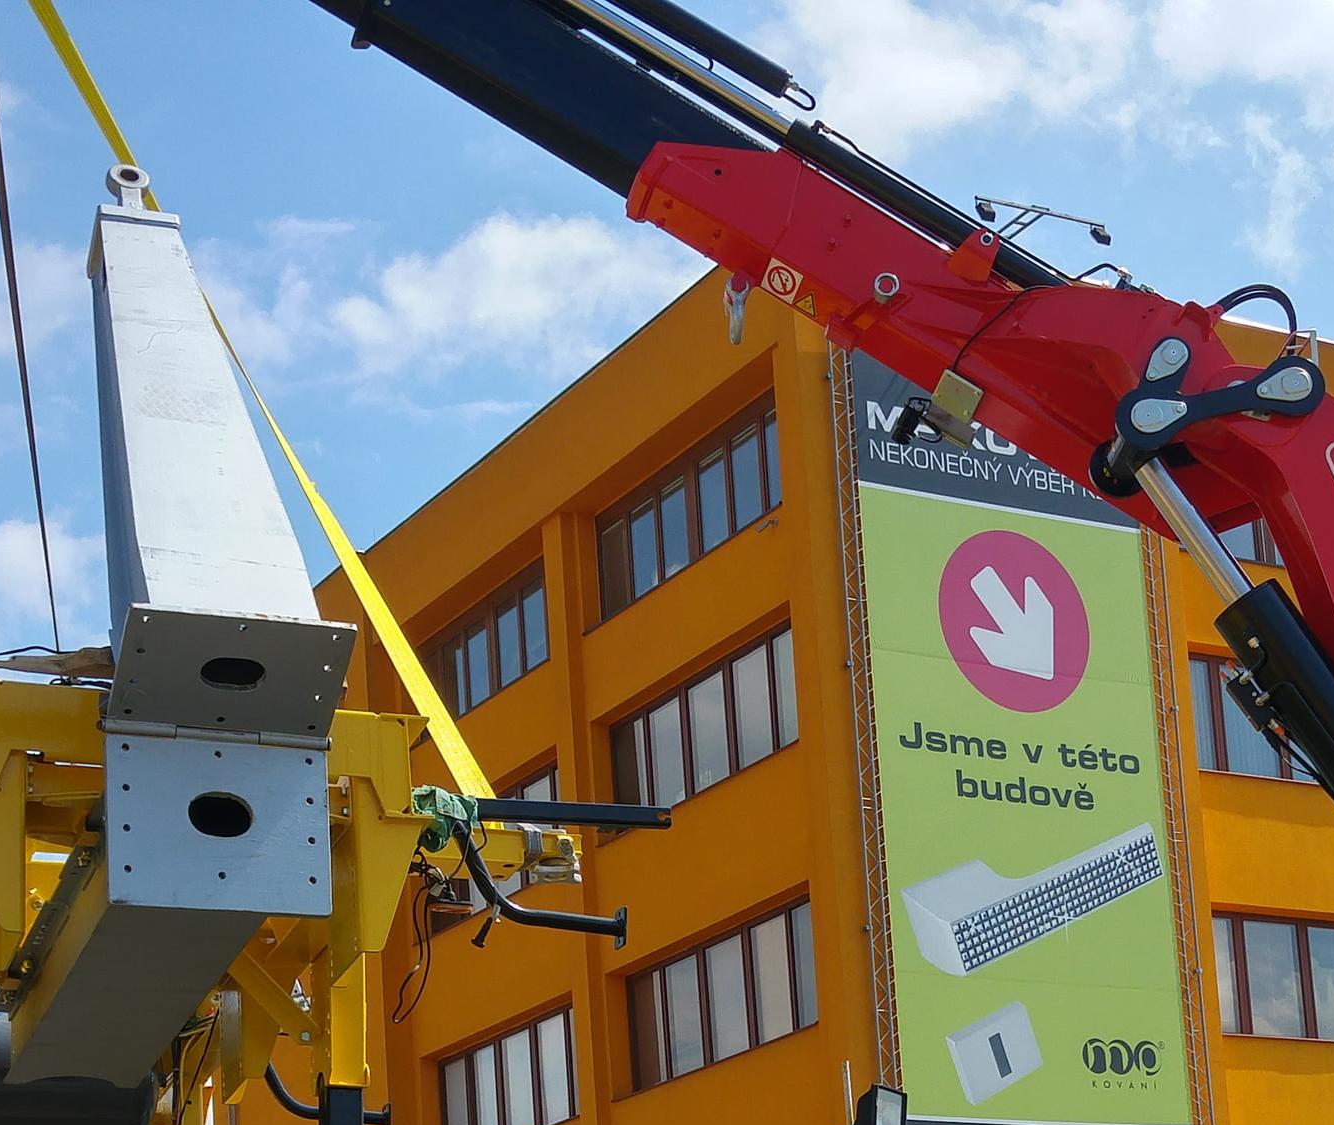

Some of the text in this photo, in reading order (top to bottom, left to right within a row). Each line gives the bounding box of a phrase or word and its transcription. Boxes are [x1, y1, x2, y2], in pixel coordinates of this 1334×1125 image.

[869, 438, 1002, 482] NEKONEČNÝ
[899, 721, 1141, 775] Jsme v této
[955, 769, 1095, 811] budově
